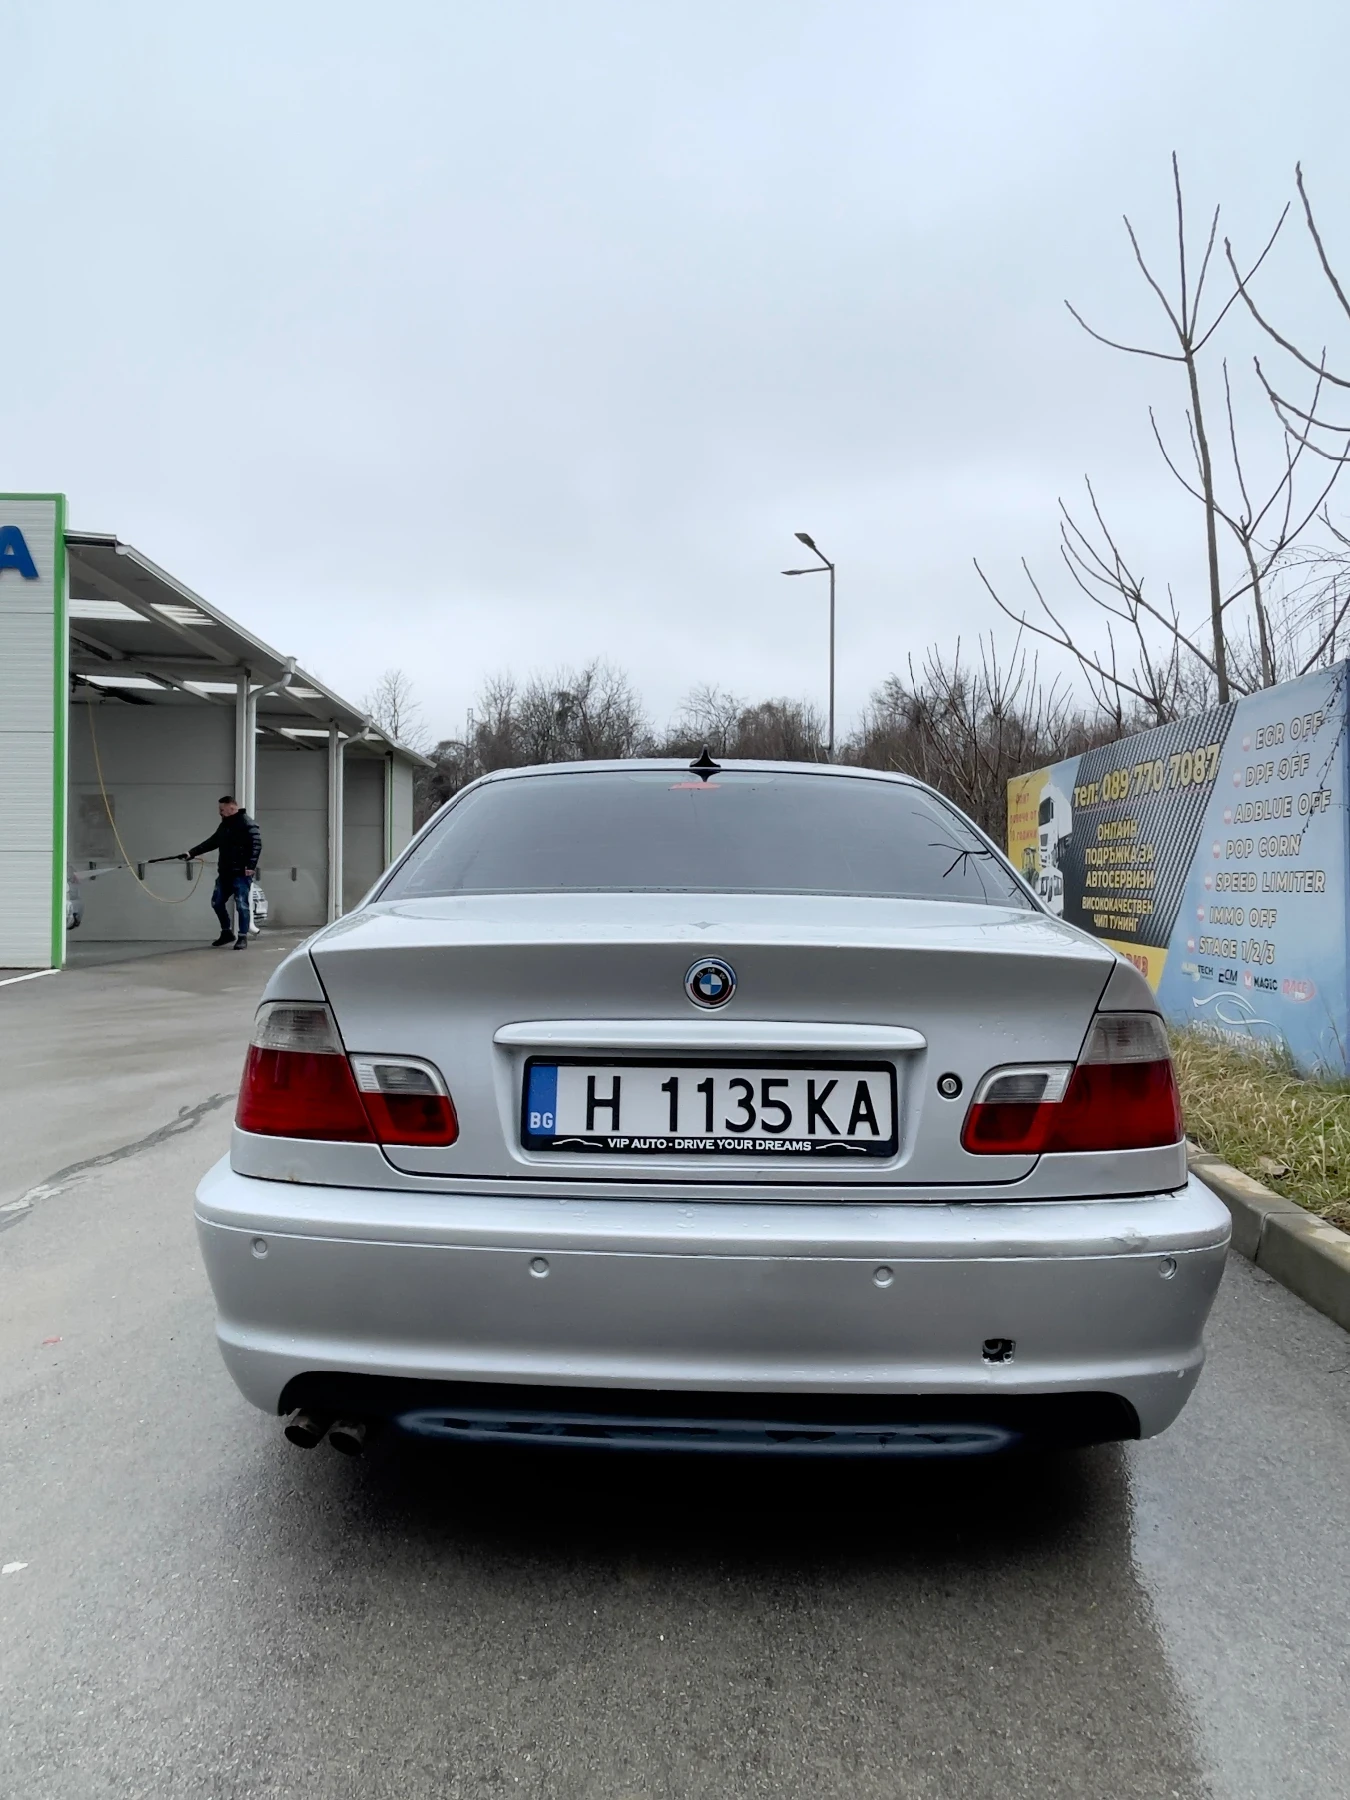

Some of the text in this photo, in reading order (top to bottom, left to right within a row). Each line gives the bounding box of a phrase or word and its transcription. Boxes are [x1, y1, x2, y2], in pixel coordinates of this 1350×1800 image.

[1256, 710, 1323, 750] EGR OFF
[1102, 767, 1130, 802] 089
[1133, 758, 1164, 797] 770
[1169, 742, 1221, 789] 7087
[1245, 753, 1310, 787] DPF OFF
[1234, 789, 1332, 824] ADBLUE OFF
[1097, 816, 1138, 841] ОНЛАЙН
[1084, 843, 1154, 867] ПОДРЪЖКА ЗА
[1226, 834, 1301, 860] POP CORN
[1085, 869, 1155, 889] АВТОСЕРВИЗИ
[1215, 870, 1326, 893] SPEED LIMITER
[1082, 896, 1154, 915] ВИСОКОКАЧЕСТВЕН
[1209, 906, 1277, 928] IMMO OFF
[1109, 915, 1139, 932] ТУНИНГ
[1199, 936, 1275, 965] STAGE 1/2/3
[661, 1076, 792, 1134] 1135
[530, 1111, 553, 1129] BG
[607, 1138, 630, 1149] VIP
[631, 1138, 667, 1149] AUTO
[674, 1139, 714, 1150] DRIVE
[716, 1139, 753, 1150] YOUR
[755, 1140, 812, 1151] DREAMS
